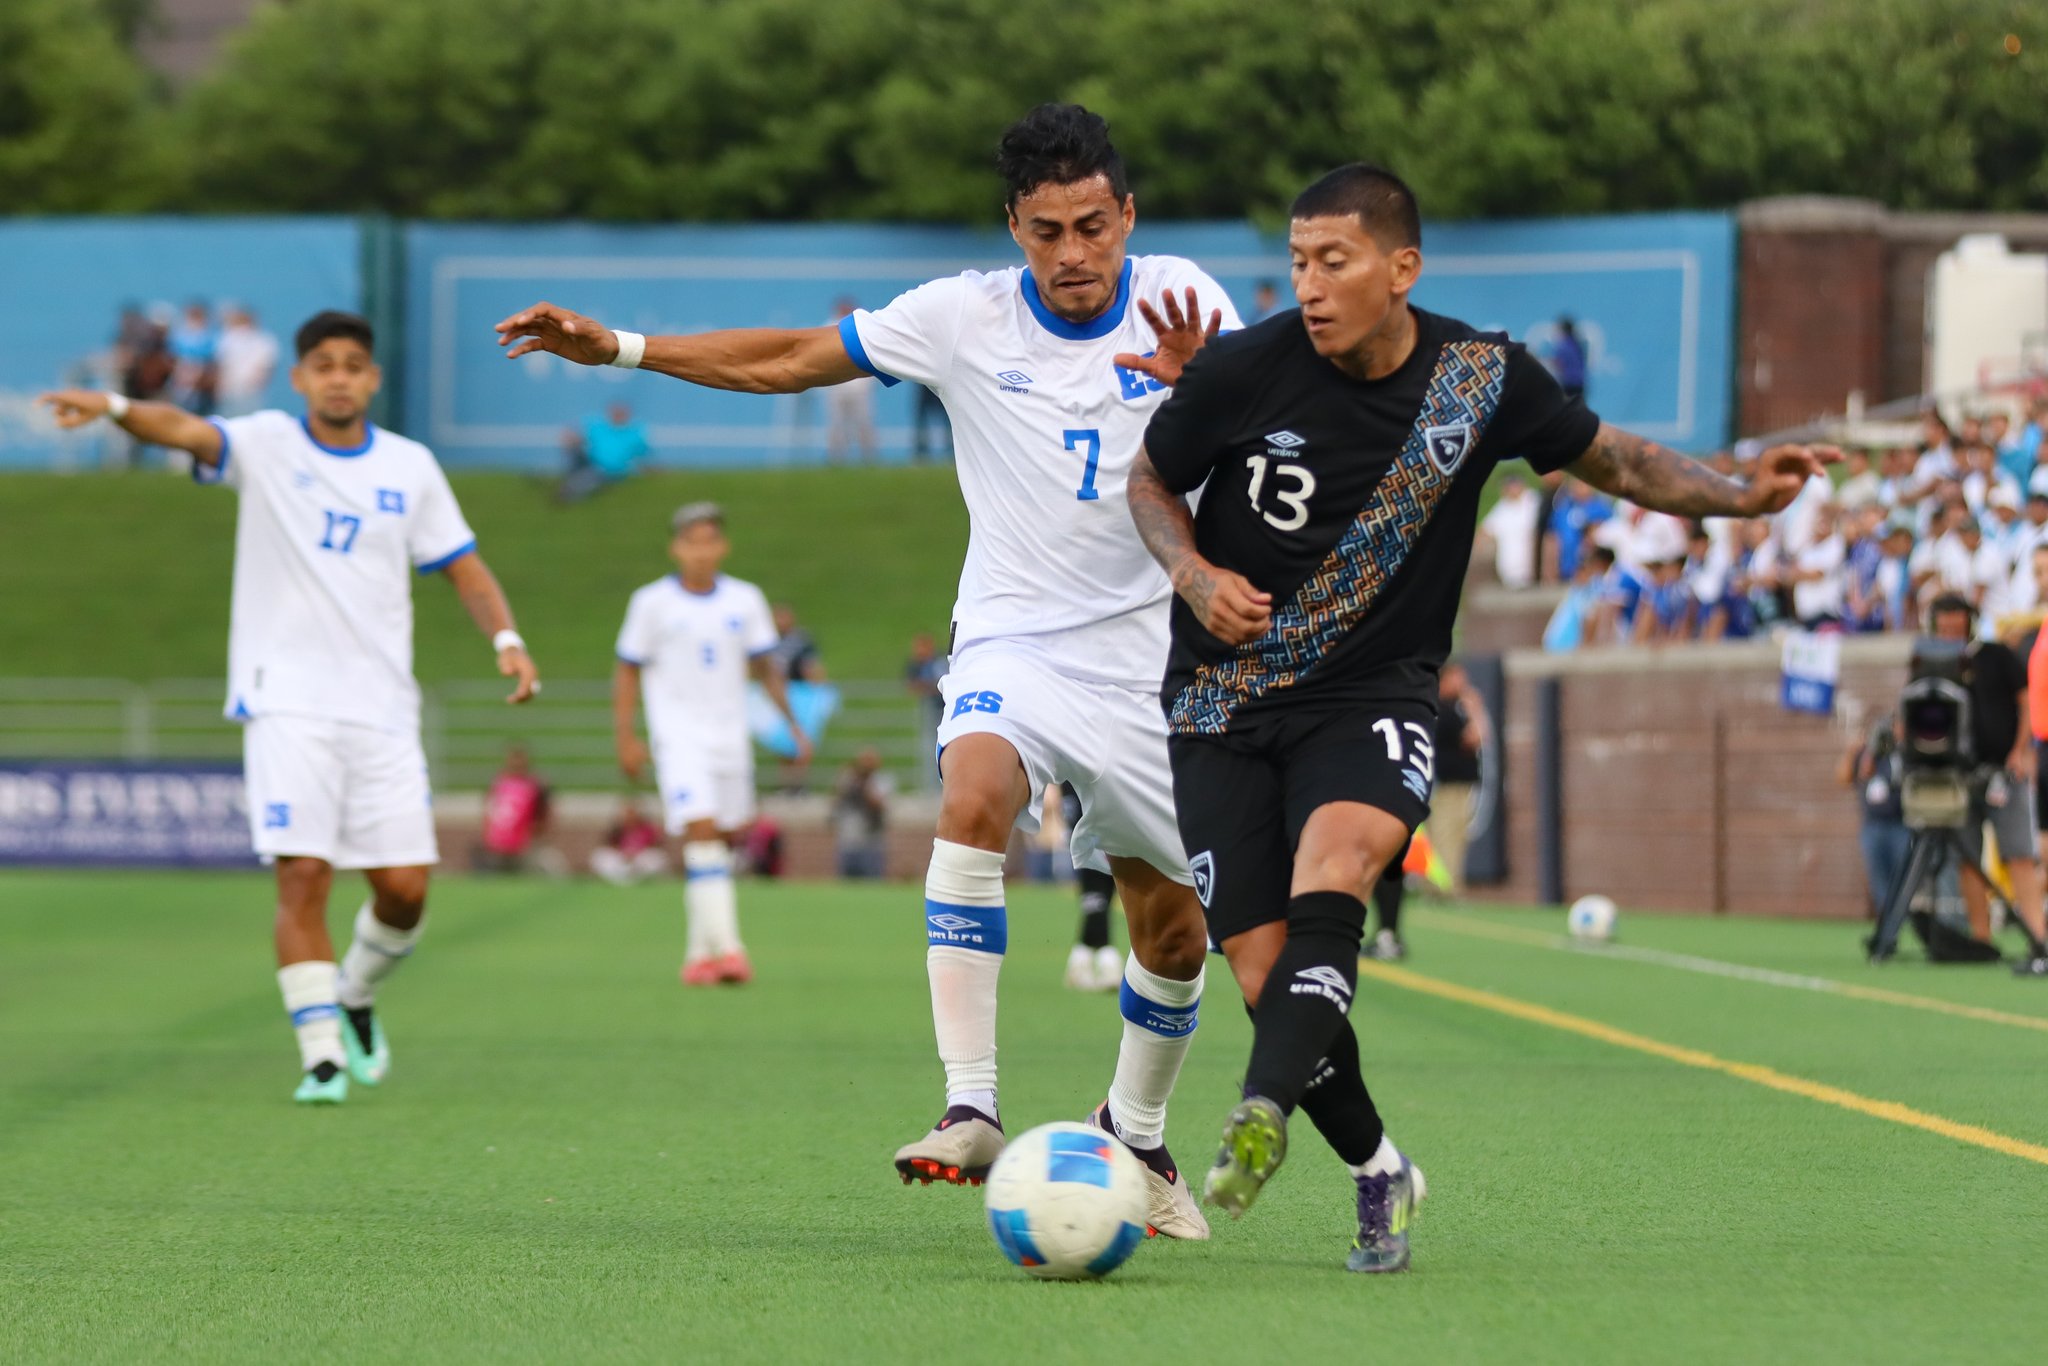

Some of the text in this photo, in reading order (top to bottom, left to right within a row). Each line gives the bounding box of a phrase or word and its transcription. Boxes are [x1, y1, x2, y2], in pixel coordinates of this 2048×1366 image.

[999, 384, 1029, 395] umbro
[1063, 429, 1101, 501] 7
[1267, 447, 1300, 458] umbro
[1246, 454, 1316, 532] 13
[320, 510, 360, 553] 17
[951, 690, 1004, 721] ES
[1371, 717, 1434, 782] 13
[1289, 983, 1348, 1015] umbro
[1146, 1019, 1193, 1031] umb
